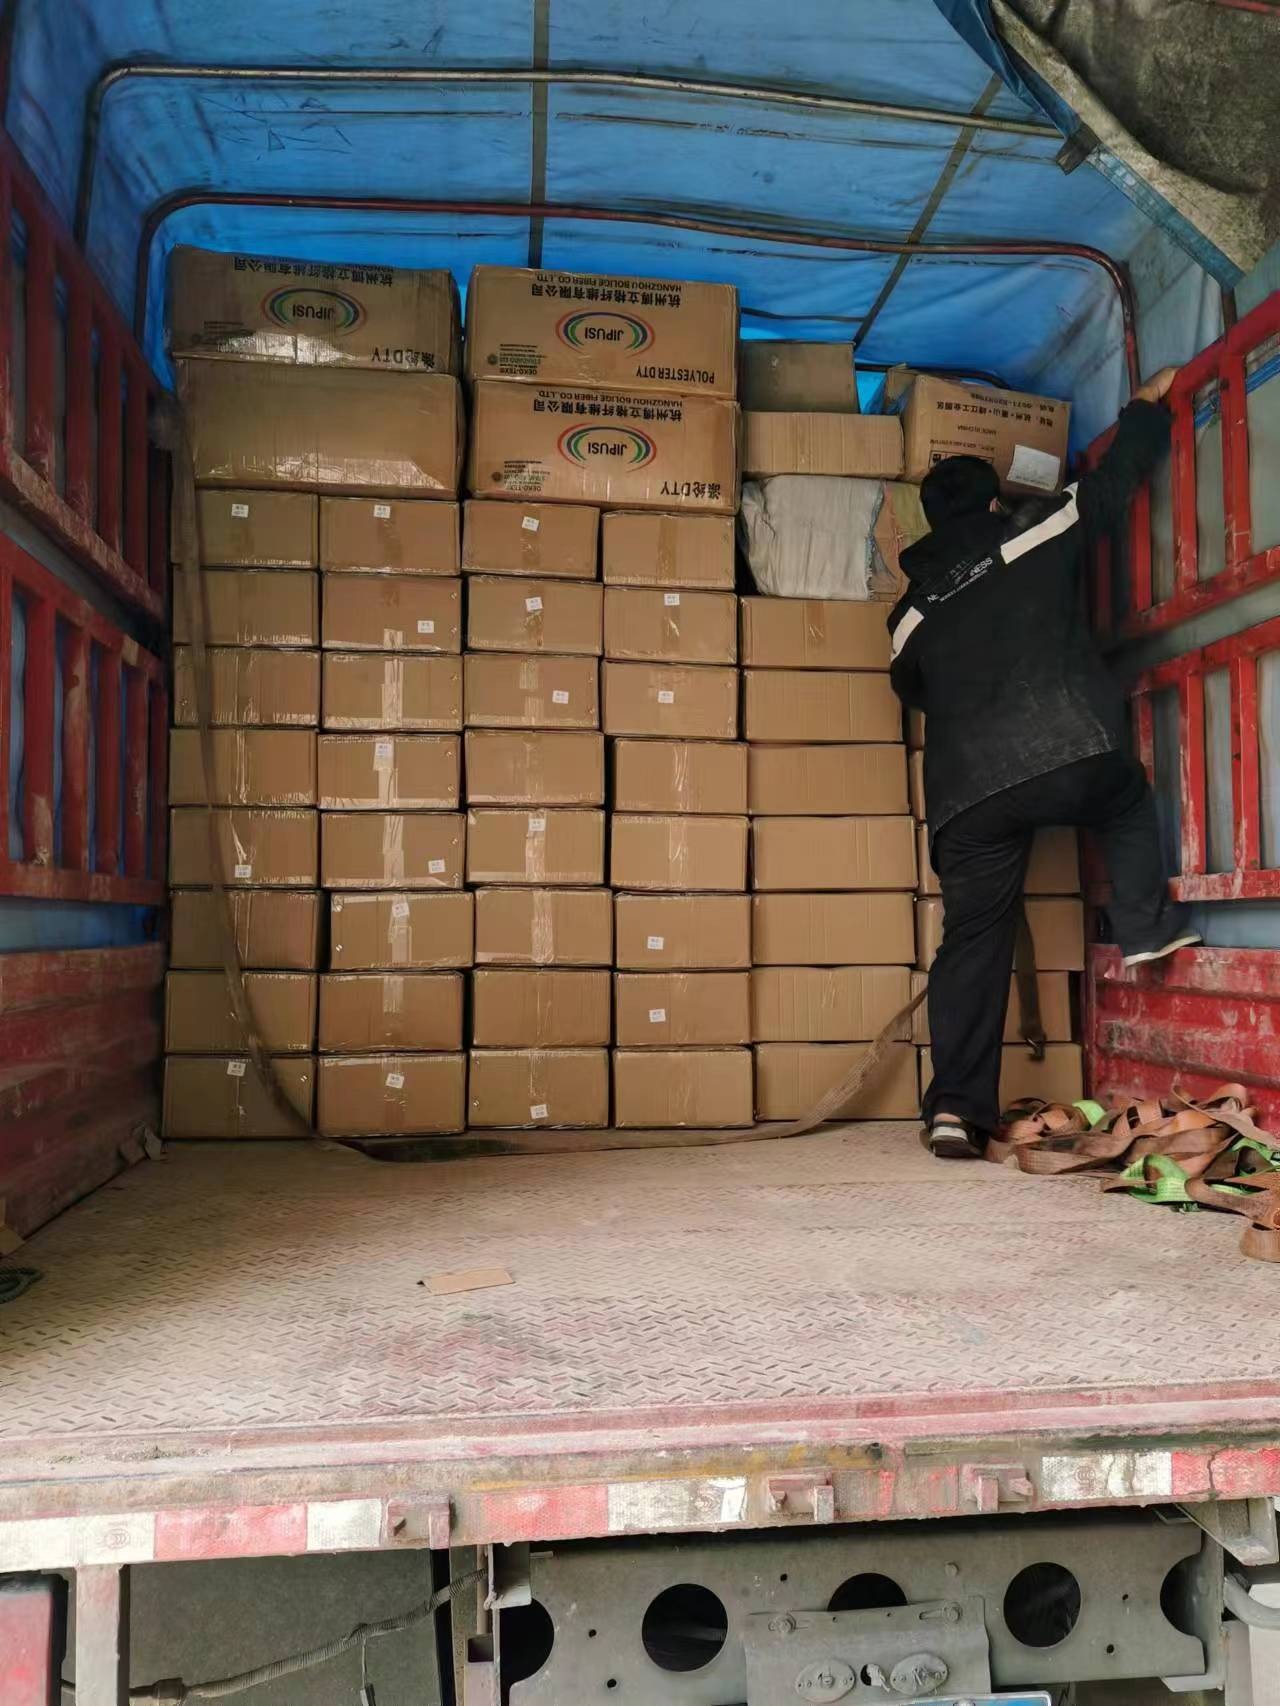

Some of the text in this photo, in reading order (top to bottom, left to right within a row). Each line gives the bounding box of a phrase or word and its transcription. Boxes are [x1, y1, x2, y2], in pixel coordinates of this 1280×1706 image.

[572, 277, 596, 286] FIBER
[598, 278, 630, 288] BOLIGE
[631, 280, 682, 292] HANGZHOU
[531, 283, 681, 306] 杭州博立格纤维有限公司
[292, 304, 335, 320] JIPUSI
[585, 327, 624, 341] JIPUSI
[636, 365, 715, 384] POLYESTER DTY
[574, 391, 597, 401] FIBER
[598, 393, 631, 405] BOLIGE
[632, 395, 683, 408] HANGZHOU
[533, 399, 682, 421] 杭州博立格纤维有限公司
[588, 442, 628, 456] JIPUSI
